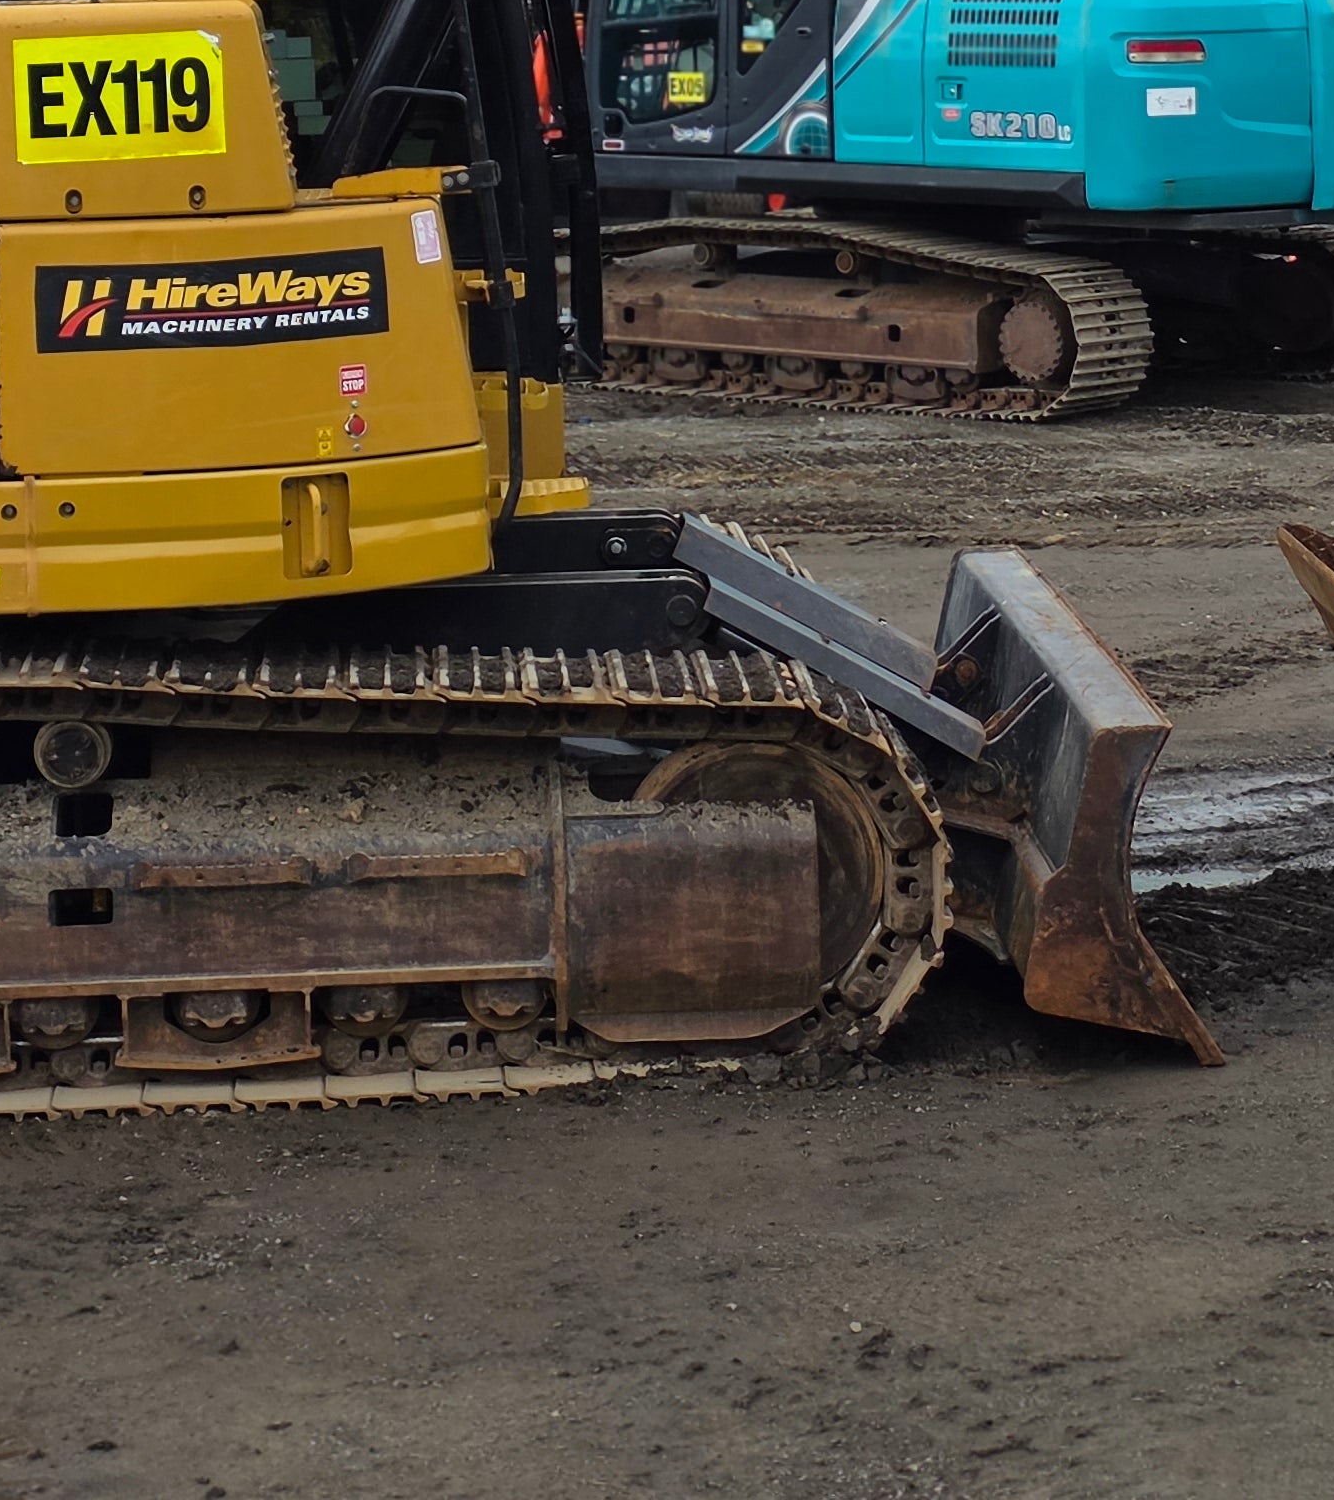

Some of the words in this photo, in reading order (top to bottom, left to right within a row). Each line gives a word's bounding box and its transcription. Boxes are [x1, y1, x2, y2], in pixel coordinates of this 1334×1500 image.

[27, 57, 210, 138] EX119
[670, 77, 704, 97] EX05
[970, 111, 1056, 139] SK210
[126, 270, 370, 311] HireWays
[121, 316, 268, 335] MACHINERY
[275, 306, 369, 327] RENTALS
[342, 379, 364, 392] STOP
